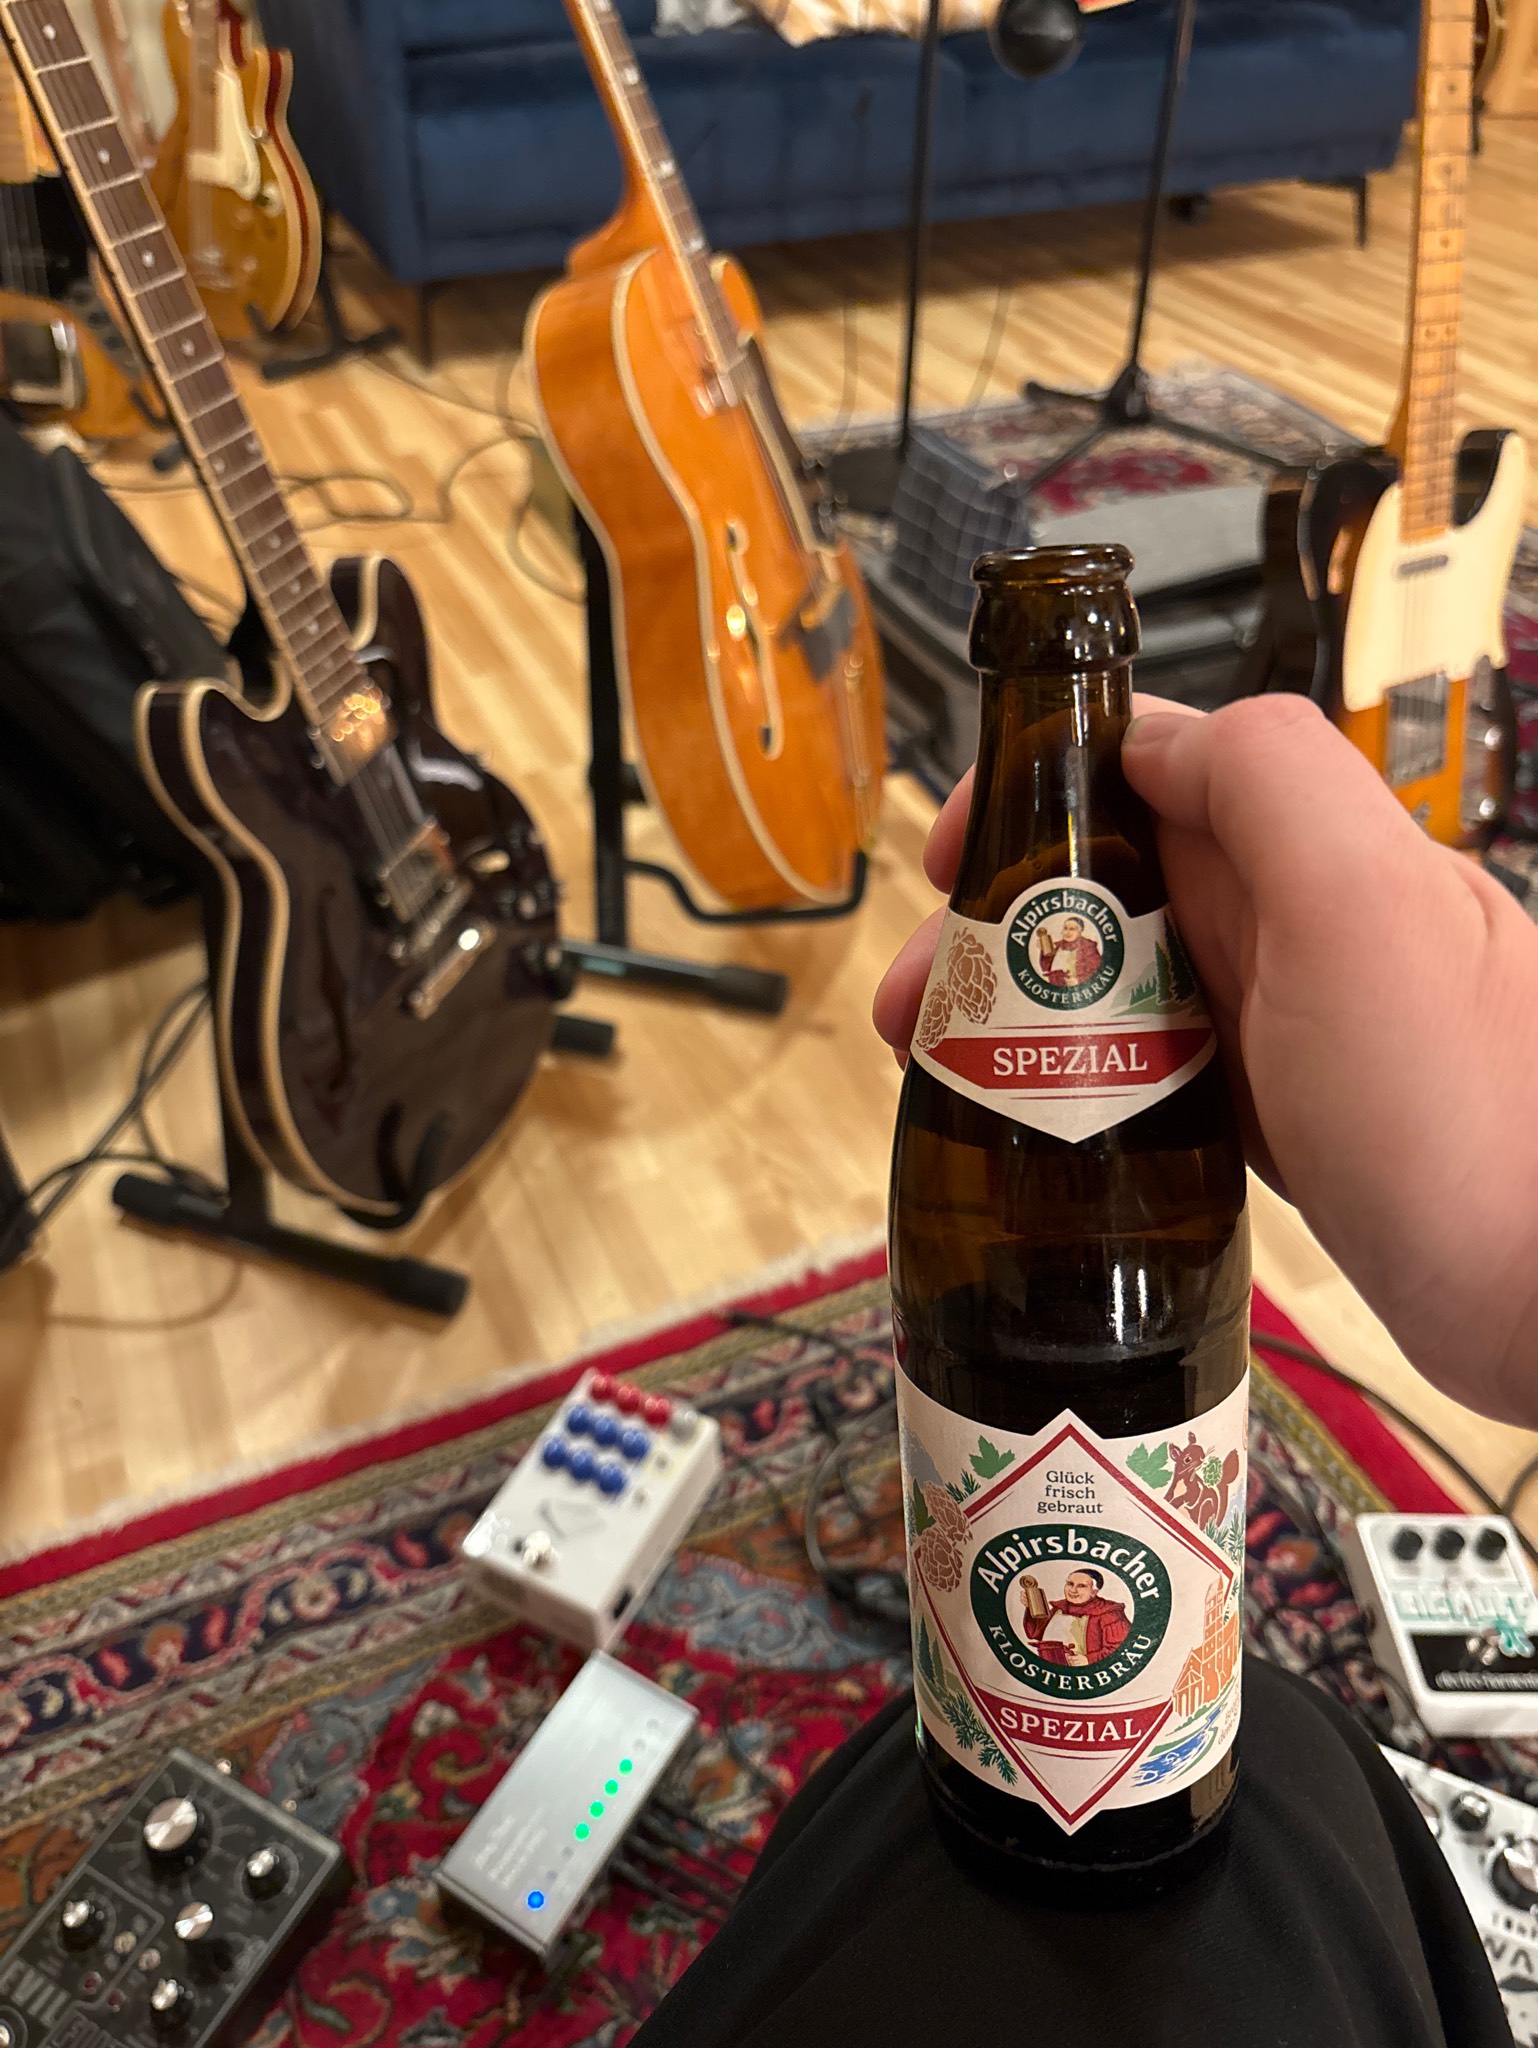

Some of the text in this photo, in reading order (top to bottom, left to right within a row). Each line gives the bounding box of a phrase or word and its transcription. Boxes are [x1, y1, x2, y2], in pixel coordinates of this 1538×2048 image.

[1010, 890, 1119, 947] Alpirsbacher
[1017, 964, 1115, 1005] KLOSTERBRÄU
[992, 1043, 1148, 1076] SPEZIAL
[1045, 1470, 1095, 1484] Glück
[1045, 1485, 1096, 1499] frisch
[1037, 1500, 1104, 1514] gebraut
[977, 1528, 1160, 1602] Alpirsbacher
[988, 1624, 1152, 1691] KLOSTERBRÄU
[1000, 1706, 1144, 1742] SPEZIAL
